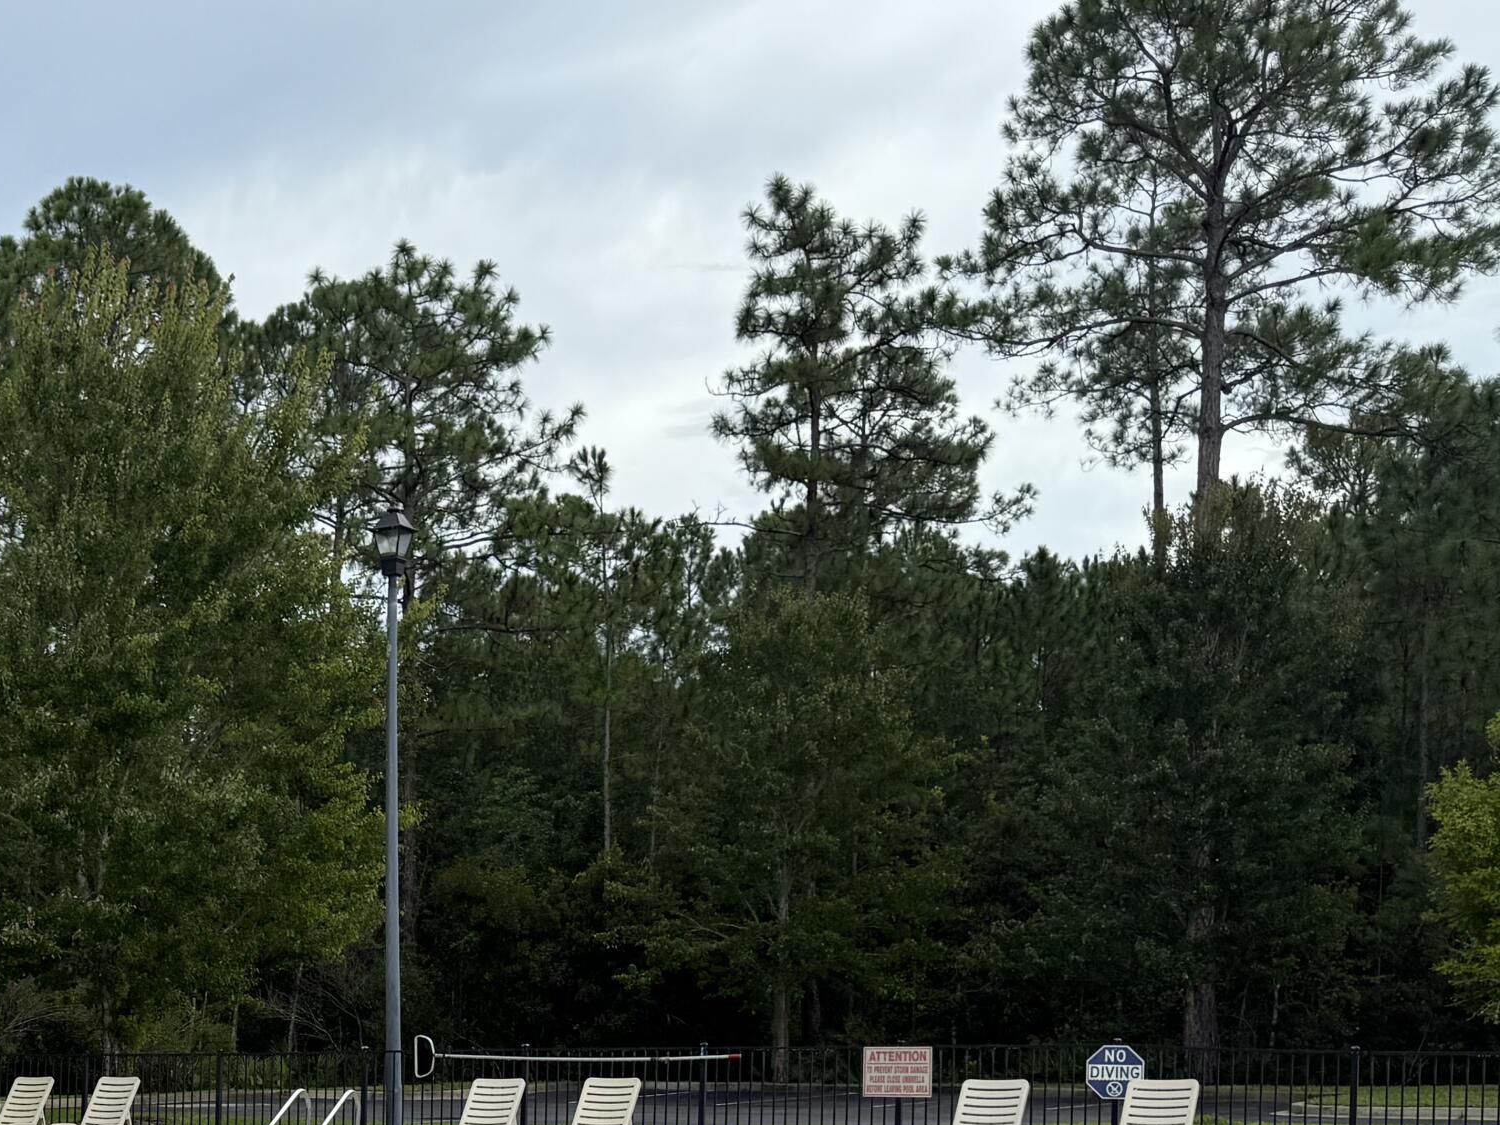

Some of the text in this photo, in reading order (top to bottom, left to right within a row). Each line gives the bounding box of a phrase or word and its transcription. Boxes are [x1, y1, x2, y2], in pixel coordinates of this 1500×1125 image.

[869, 1051, 927, 1062] ATTENTION
[1104, 1049, 1126, 1062] NO
[1090, 1066, 1140, 1079] DIVING
[869, 1075, 885, 1083] PLEASE
